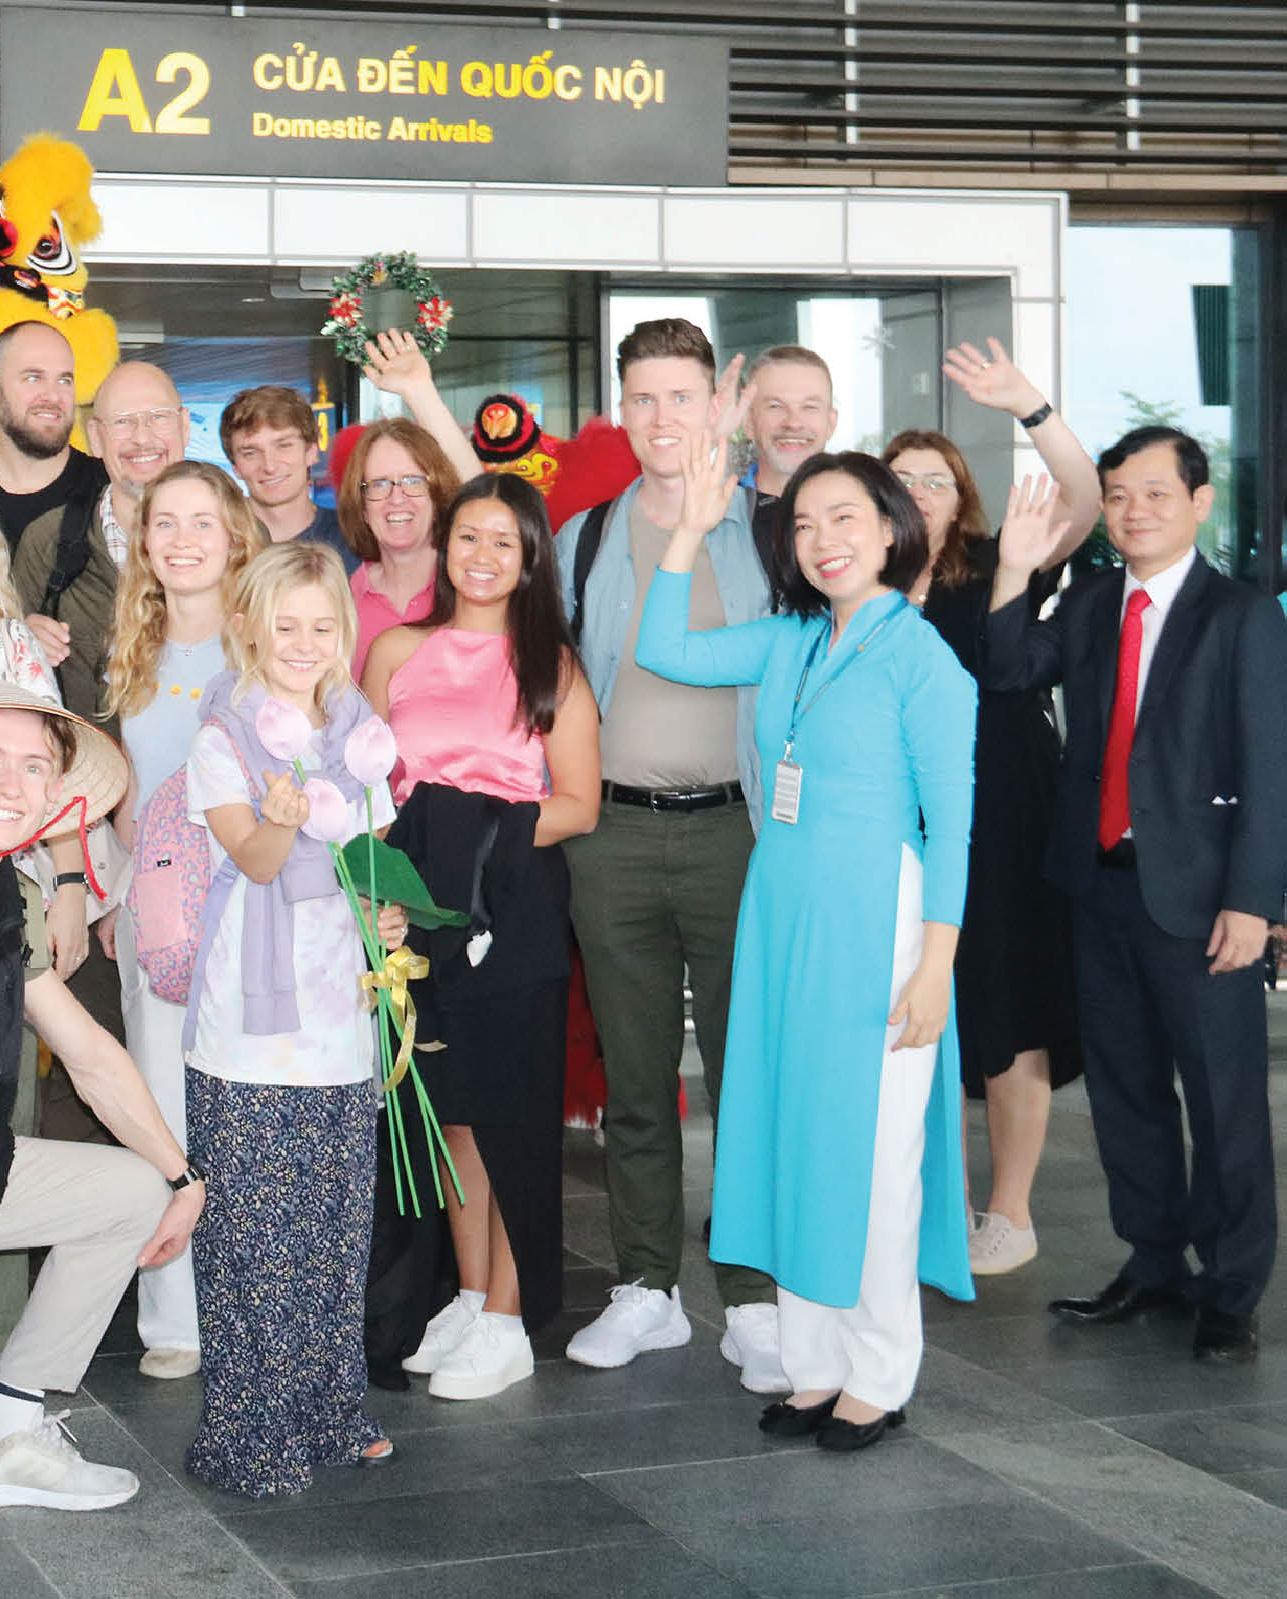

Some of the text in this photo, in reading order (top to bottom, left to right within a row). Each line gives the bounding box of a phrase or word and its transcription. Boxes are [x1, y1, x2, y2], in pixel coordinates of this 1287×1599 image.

[76, 48, 211, 135] A2
[253, 42, 664, 110] CỬA ĐẾN QUỐC NỘI
[252, 112, 494, 143] Domestic Arrivals
